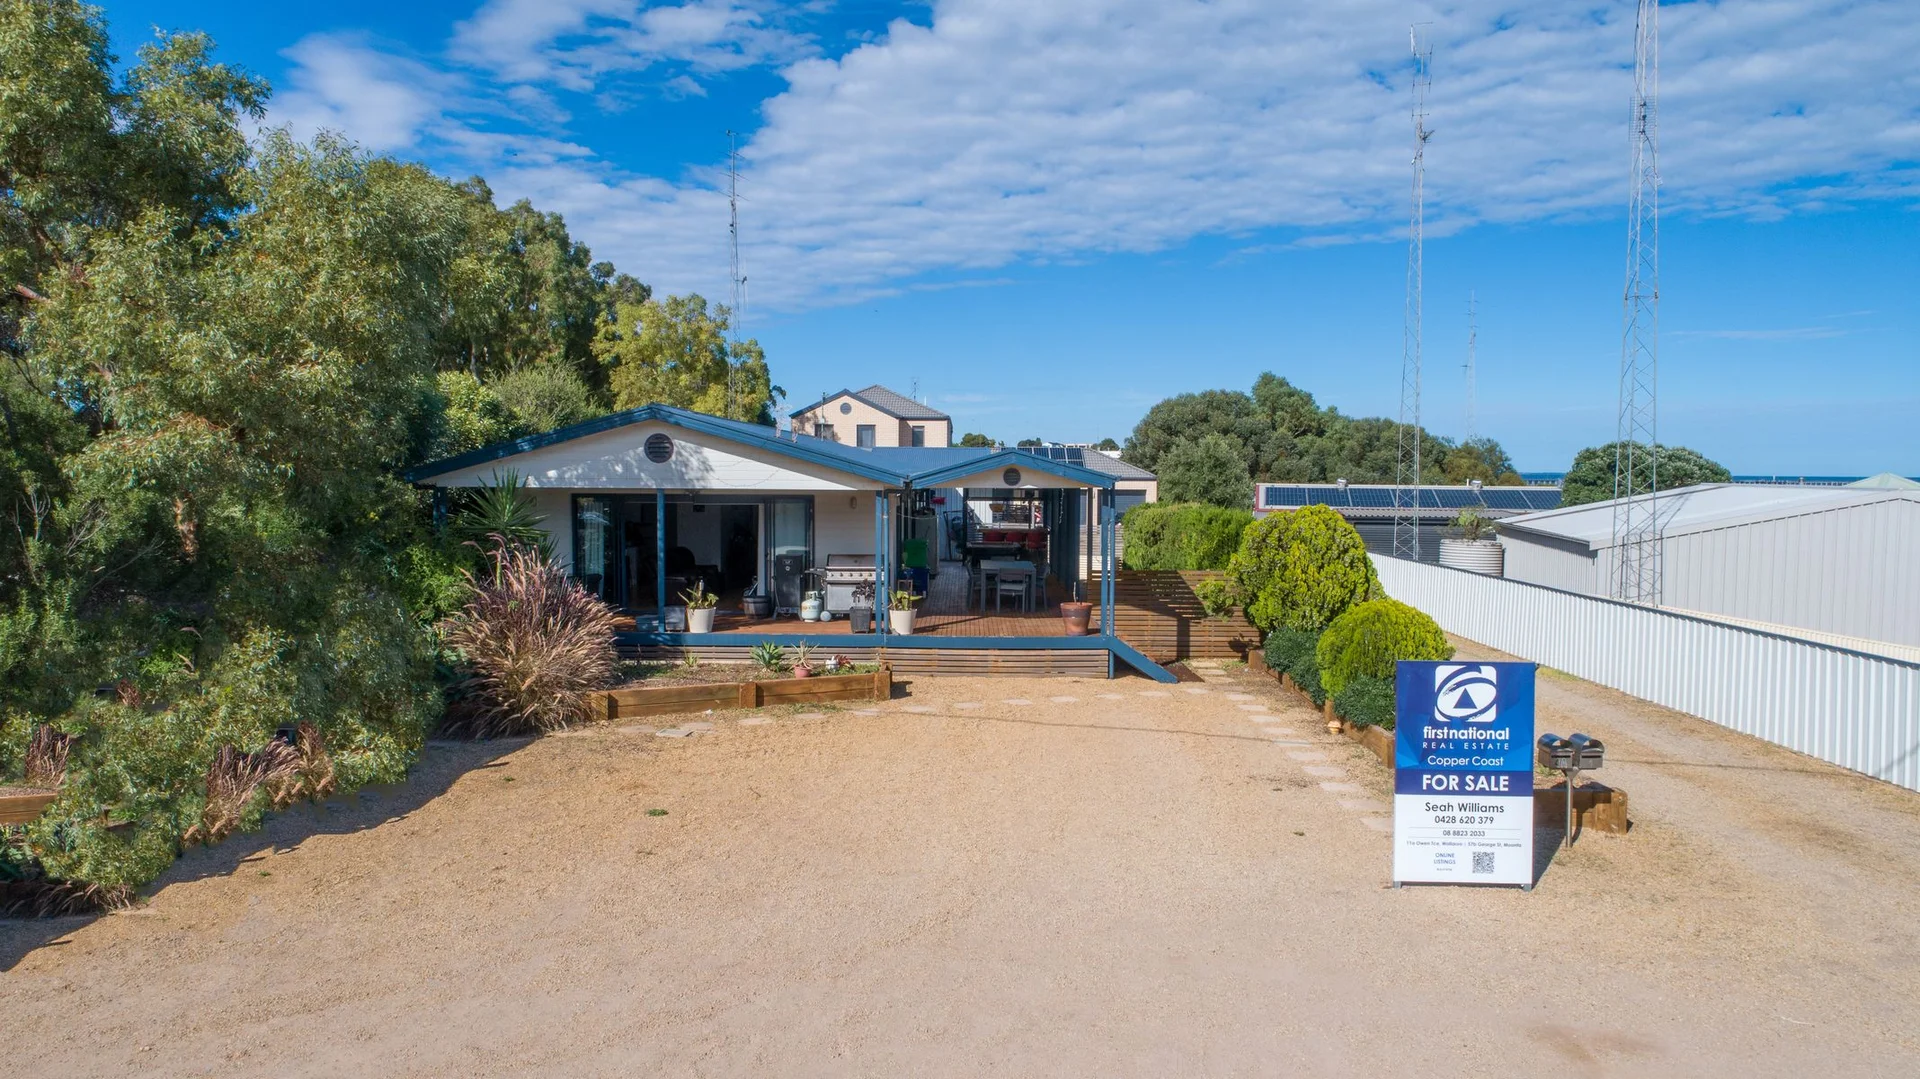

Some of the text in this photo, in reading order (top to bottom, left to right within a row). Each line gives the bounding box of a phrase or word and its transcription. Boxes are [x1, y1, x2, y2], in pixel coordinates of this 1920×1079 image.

[1427, 755, 1504, 767] Copper Coast
[1422, 774, 1509, 791] FOR SALE
[1425, 802, 1504, 813] Seah Williams
[1434, 815, 1494, 824] 0428 620 379
